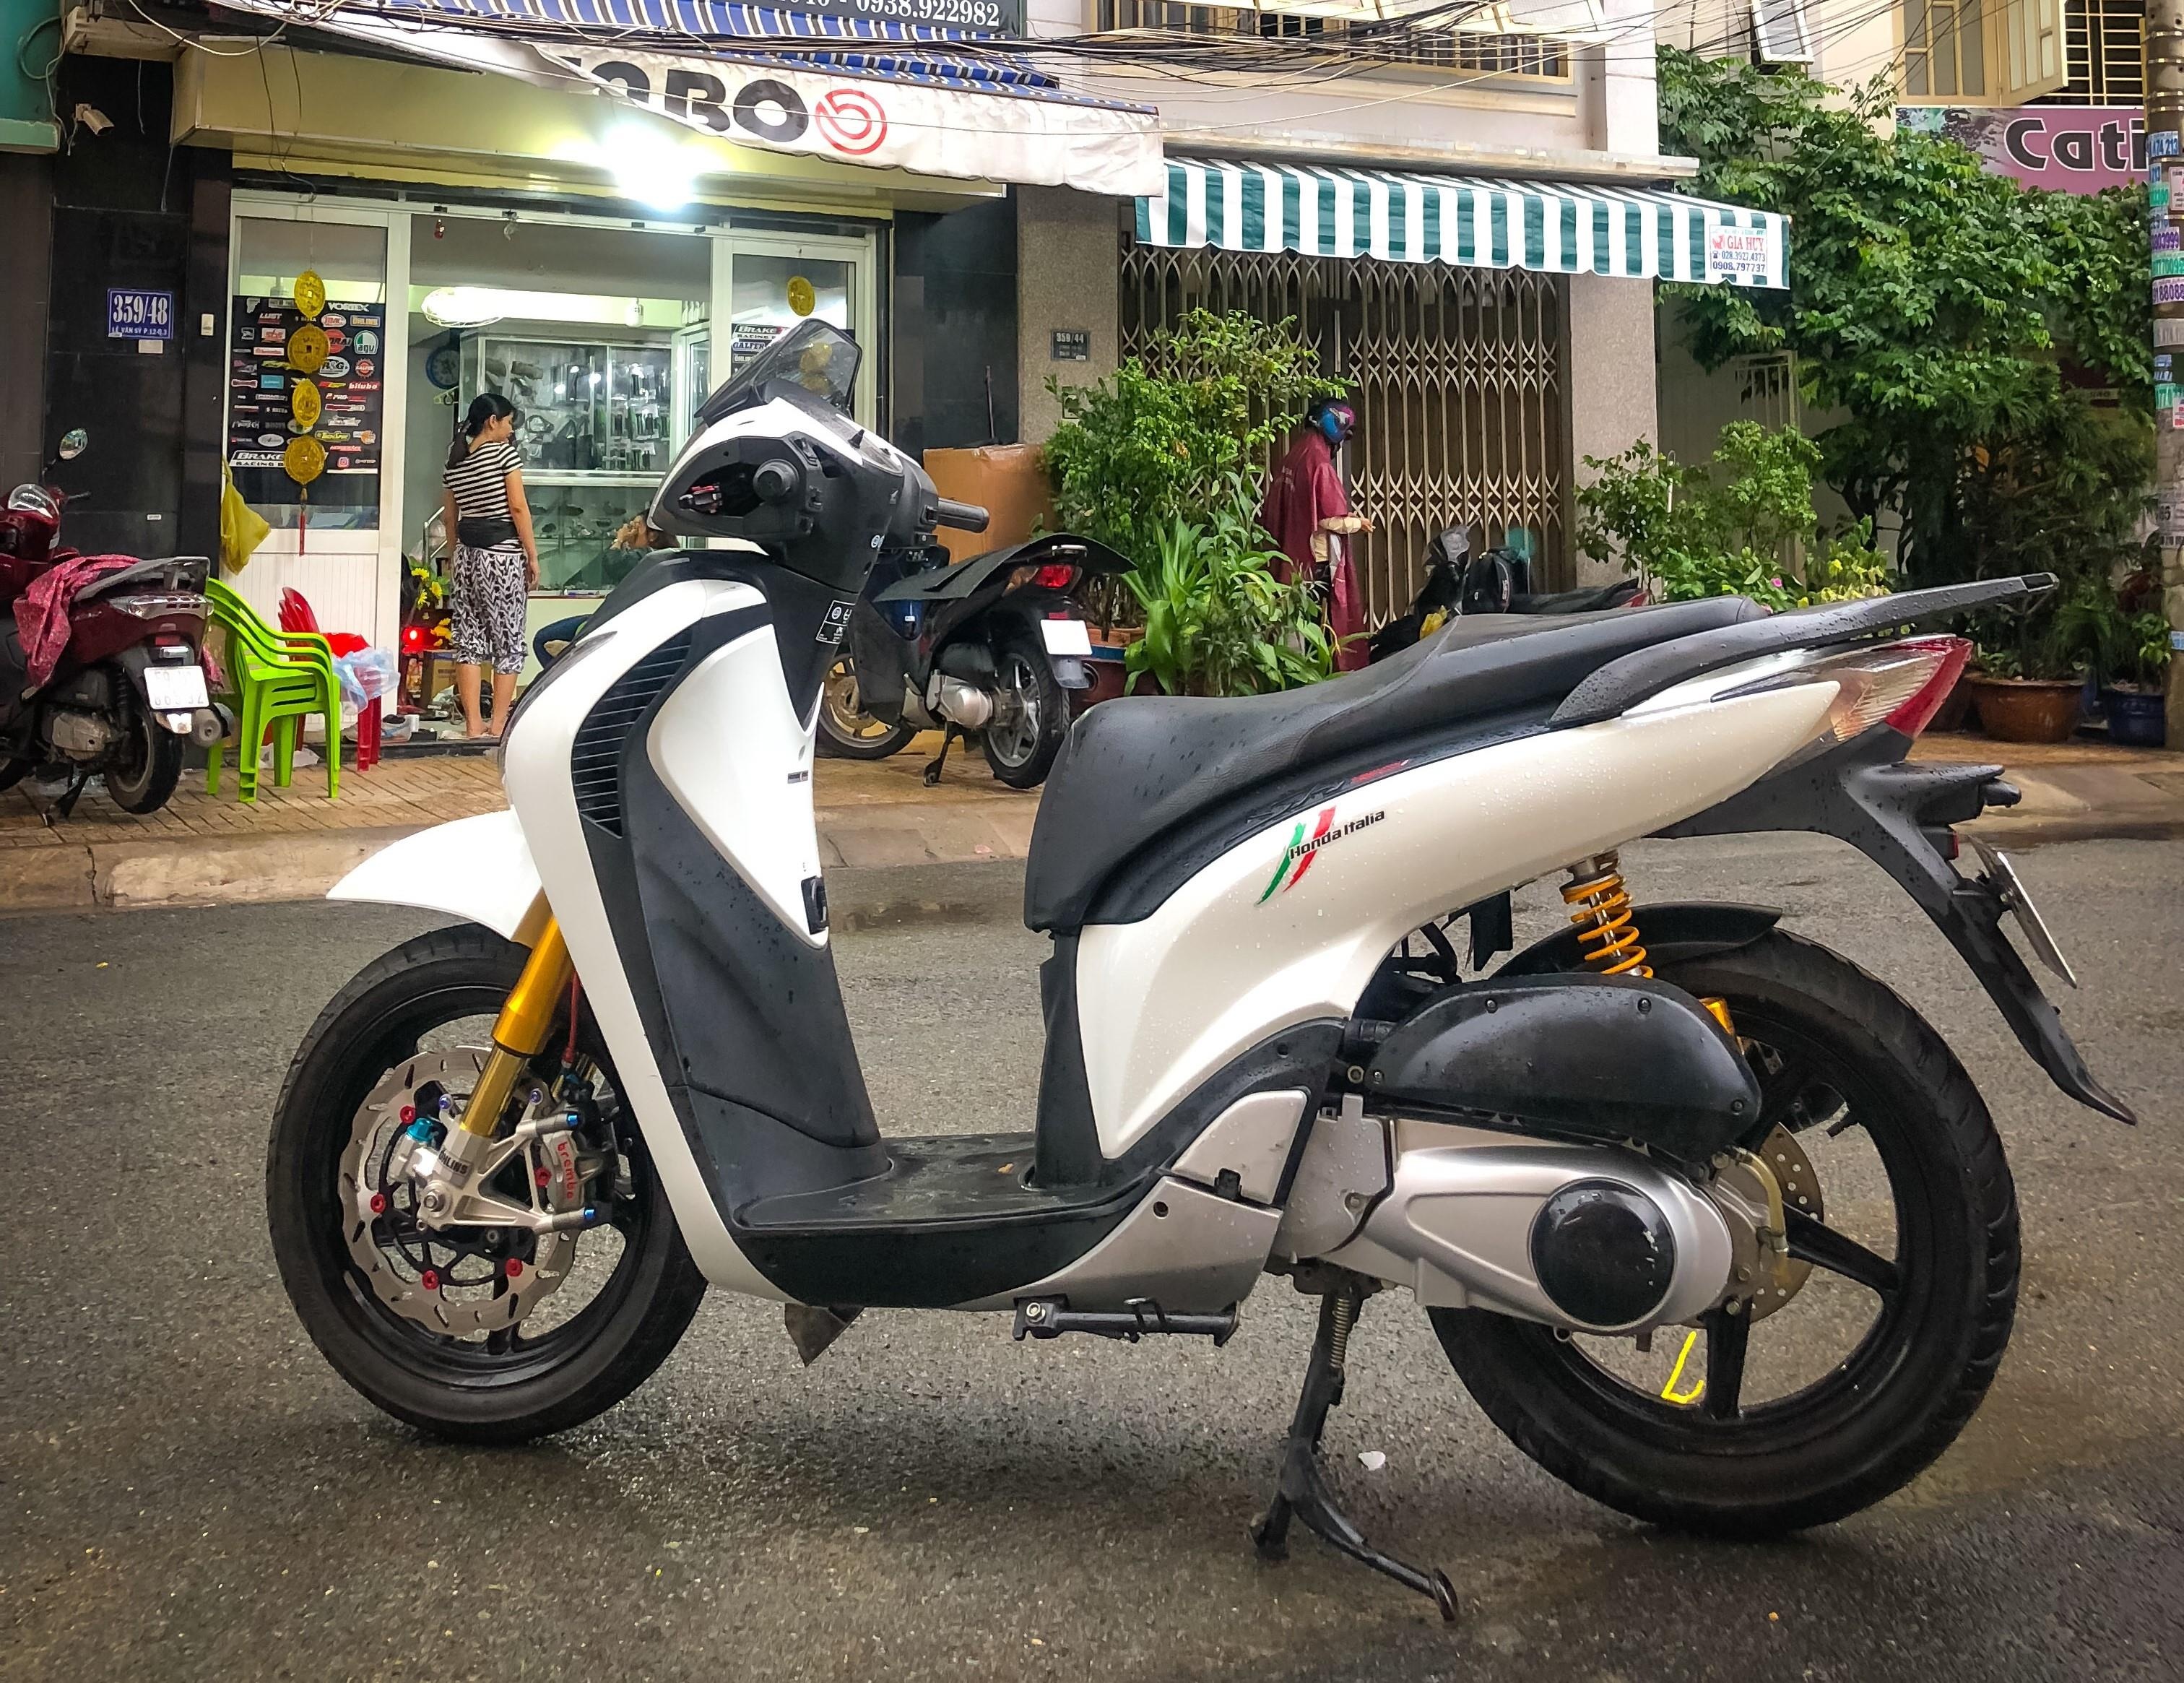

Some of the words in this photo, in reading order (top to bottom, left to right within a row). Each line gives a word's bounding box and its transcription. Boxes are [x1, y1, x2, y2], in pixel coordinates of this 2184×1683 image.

[856, 0, 1000, 27] 0938.922982
[1727, 235, 1743, 250] GIA
[1712, 261, 1766, 273] 0908.797737
[113, 295, 168, 325] 359/48
[1289, 828, 1342, 860] Honda
[1343, 810, 1385, 836] Italia
[558, 1141, 577, 1199] brembo
